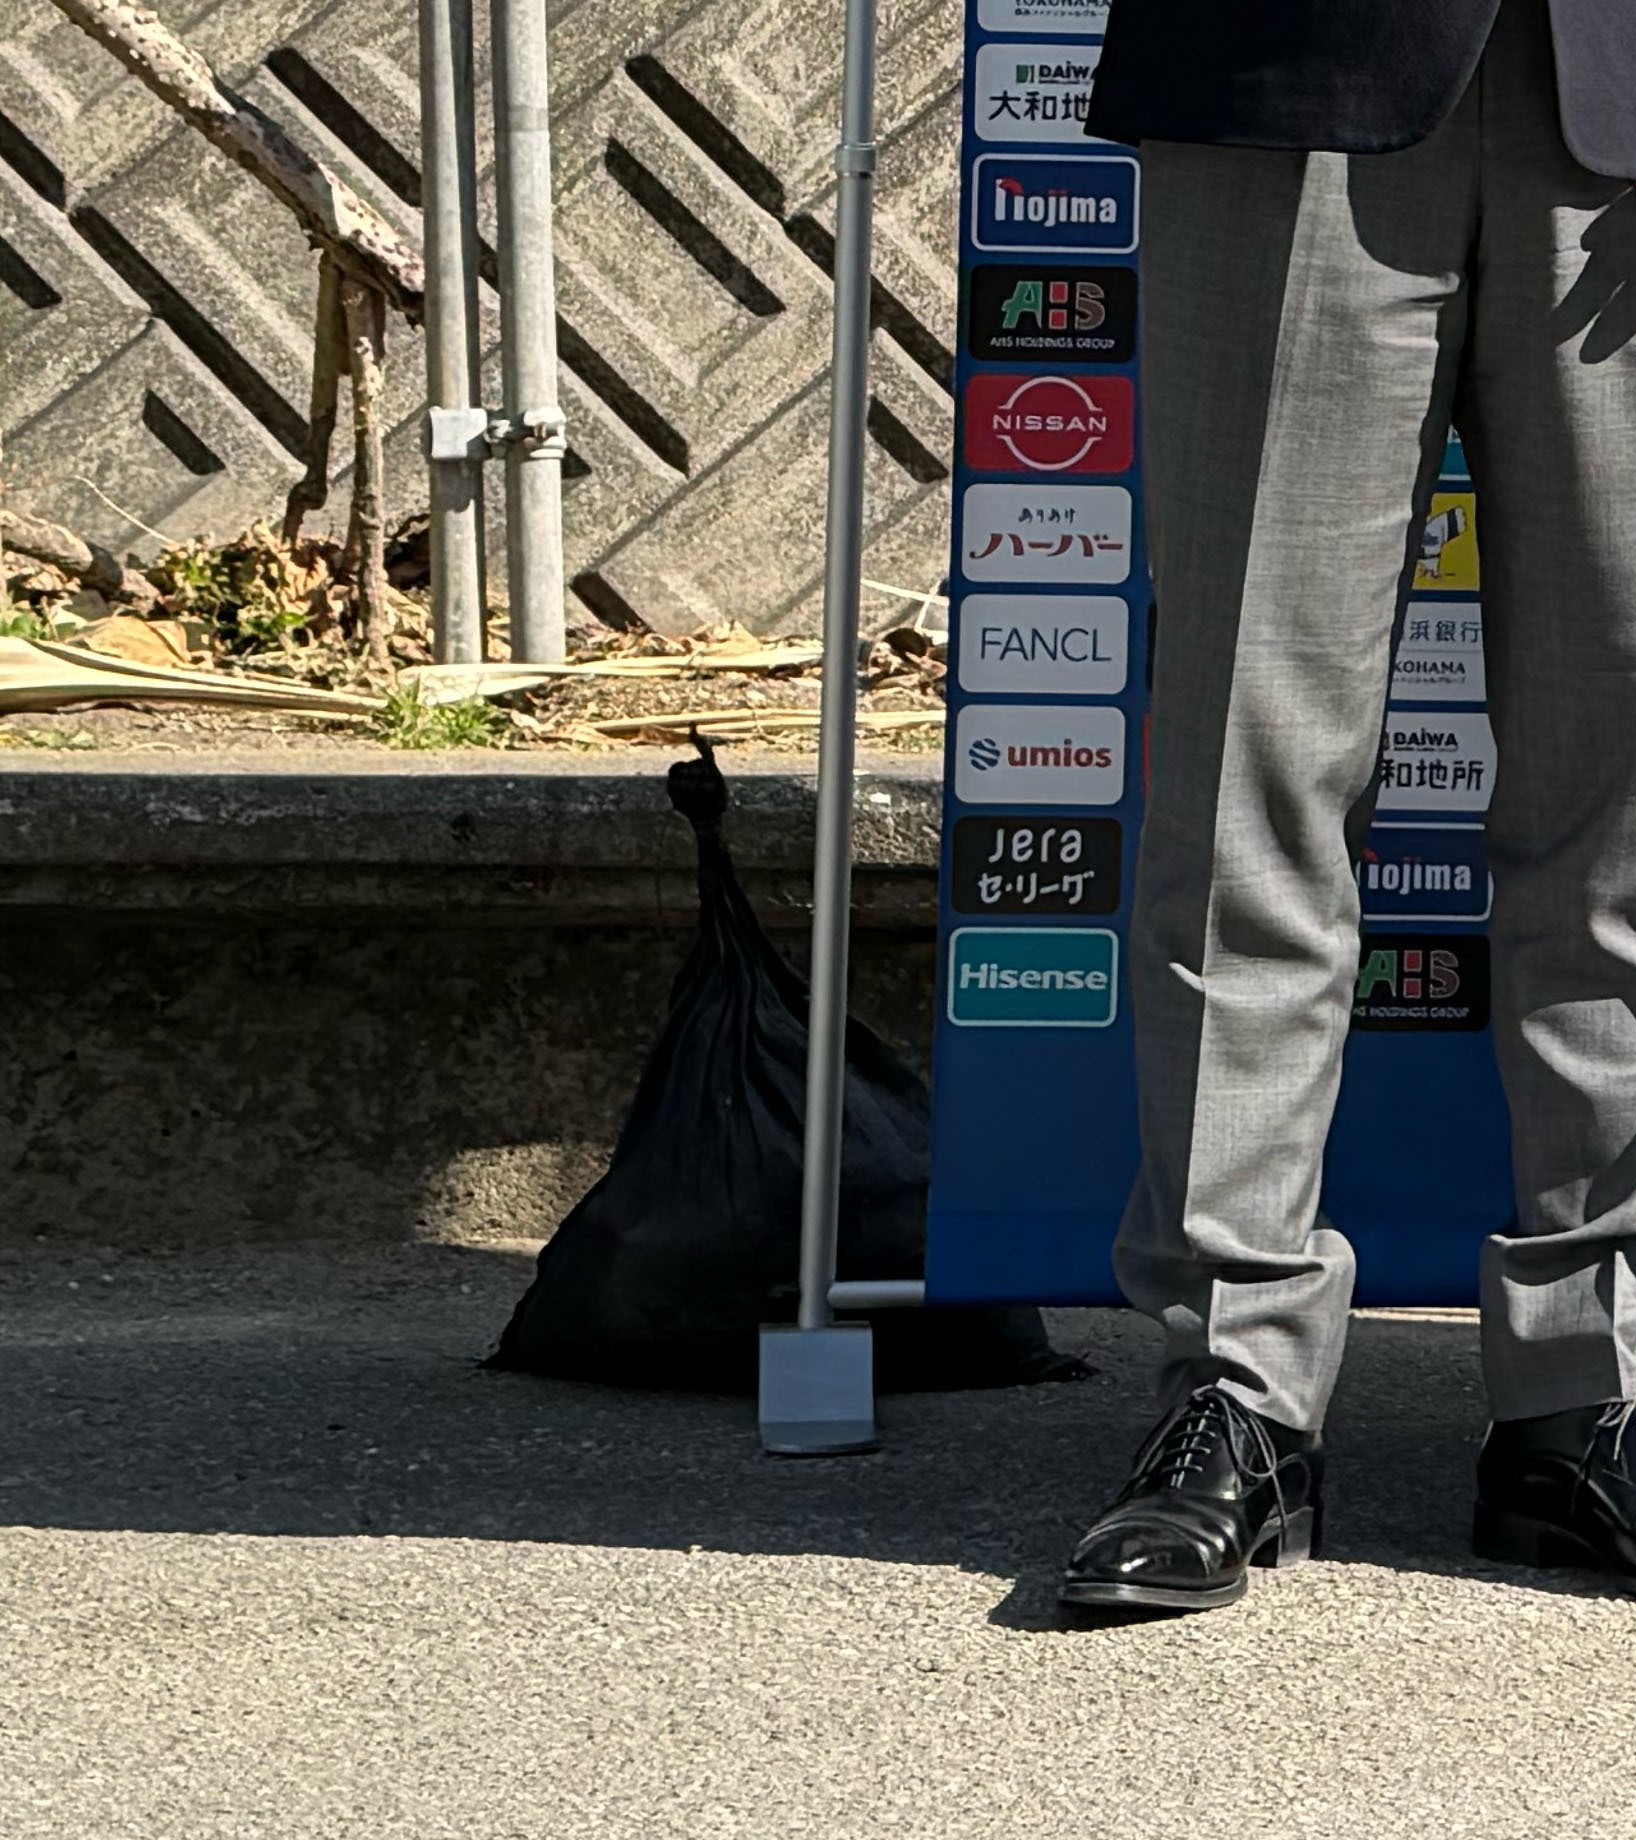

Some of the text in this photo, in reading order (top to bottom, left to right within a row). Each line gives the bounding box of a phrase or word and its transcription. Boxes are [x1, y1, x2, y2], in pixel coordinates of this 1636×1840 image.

[989, 90, 1090, 122] 大和地
[992, 414, 1107, 432] NISSAN
[969, 532, 1123, 559] ハーバー
[981, 627, 1112, 662] FANCL
[1400, 620, 1482, 643] 浜銀行
[1394, 661, 1466, 675] KOHAMA
[1007, 739, 1112, 768] umios
[1382, 760, 1484, 792] 和地所
[960, 963, 1108, 990] Hisense
